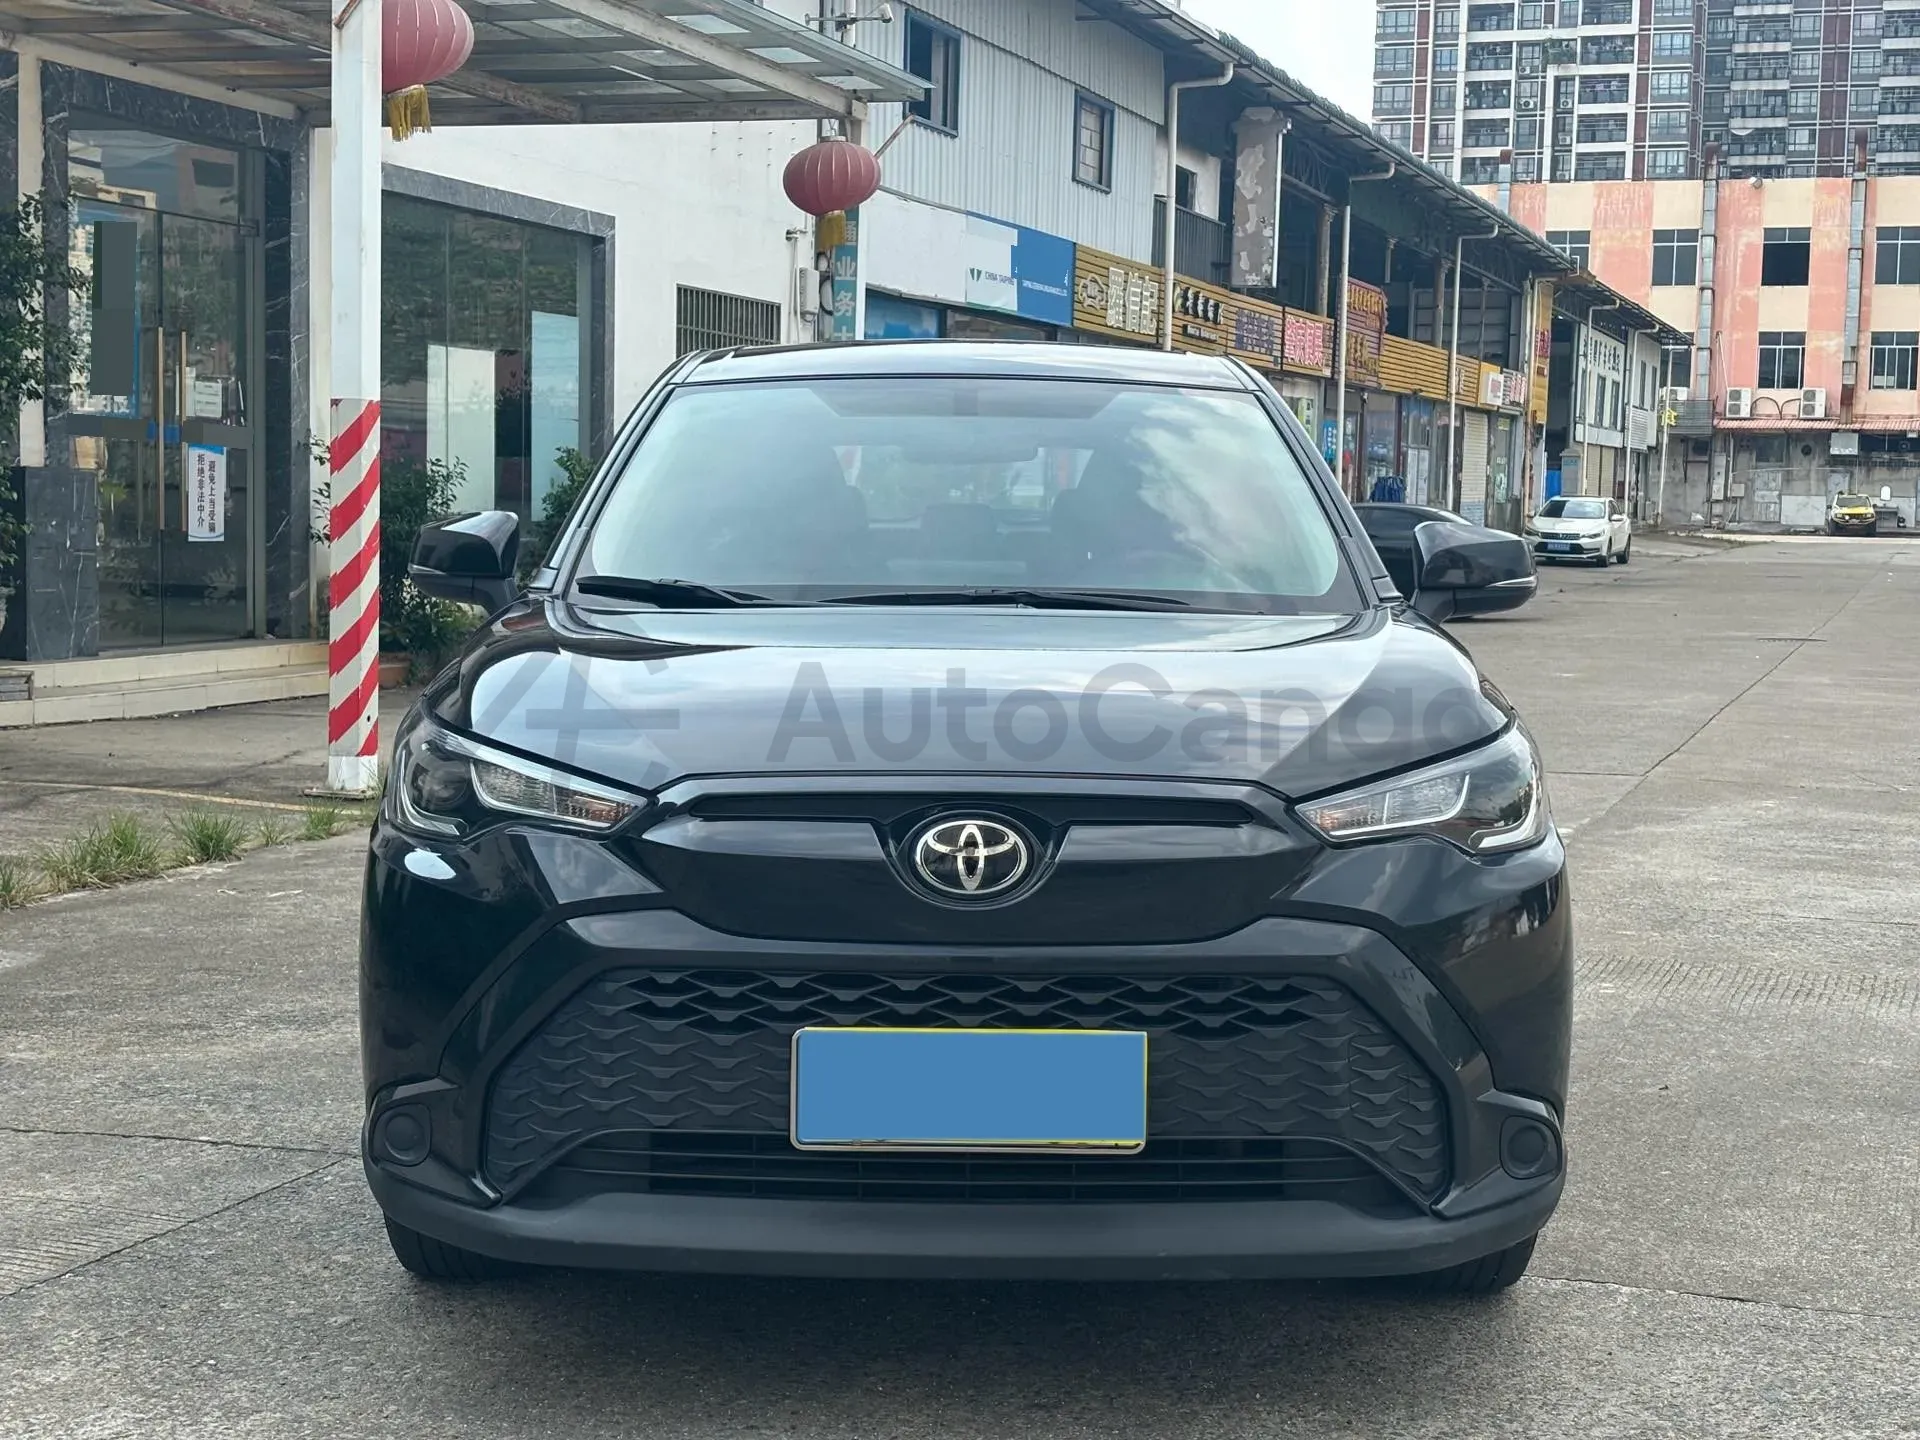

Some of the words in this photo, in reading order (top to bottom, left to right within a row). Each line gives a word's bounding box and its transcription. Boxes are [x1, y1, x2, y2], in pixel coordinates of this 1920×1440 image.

[197, 453, 205, 528] 拒绝非法中介
[208, 461, 216, 533] 避免上当受骗
